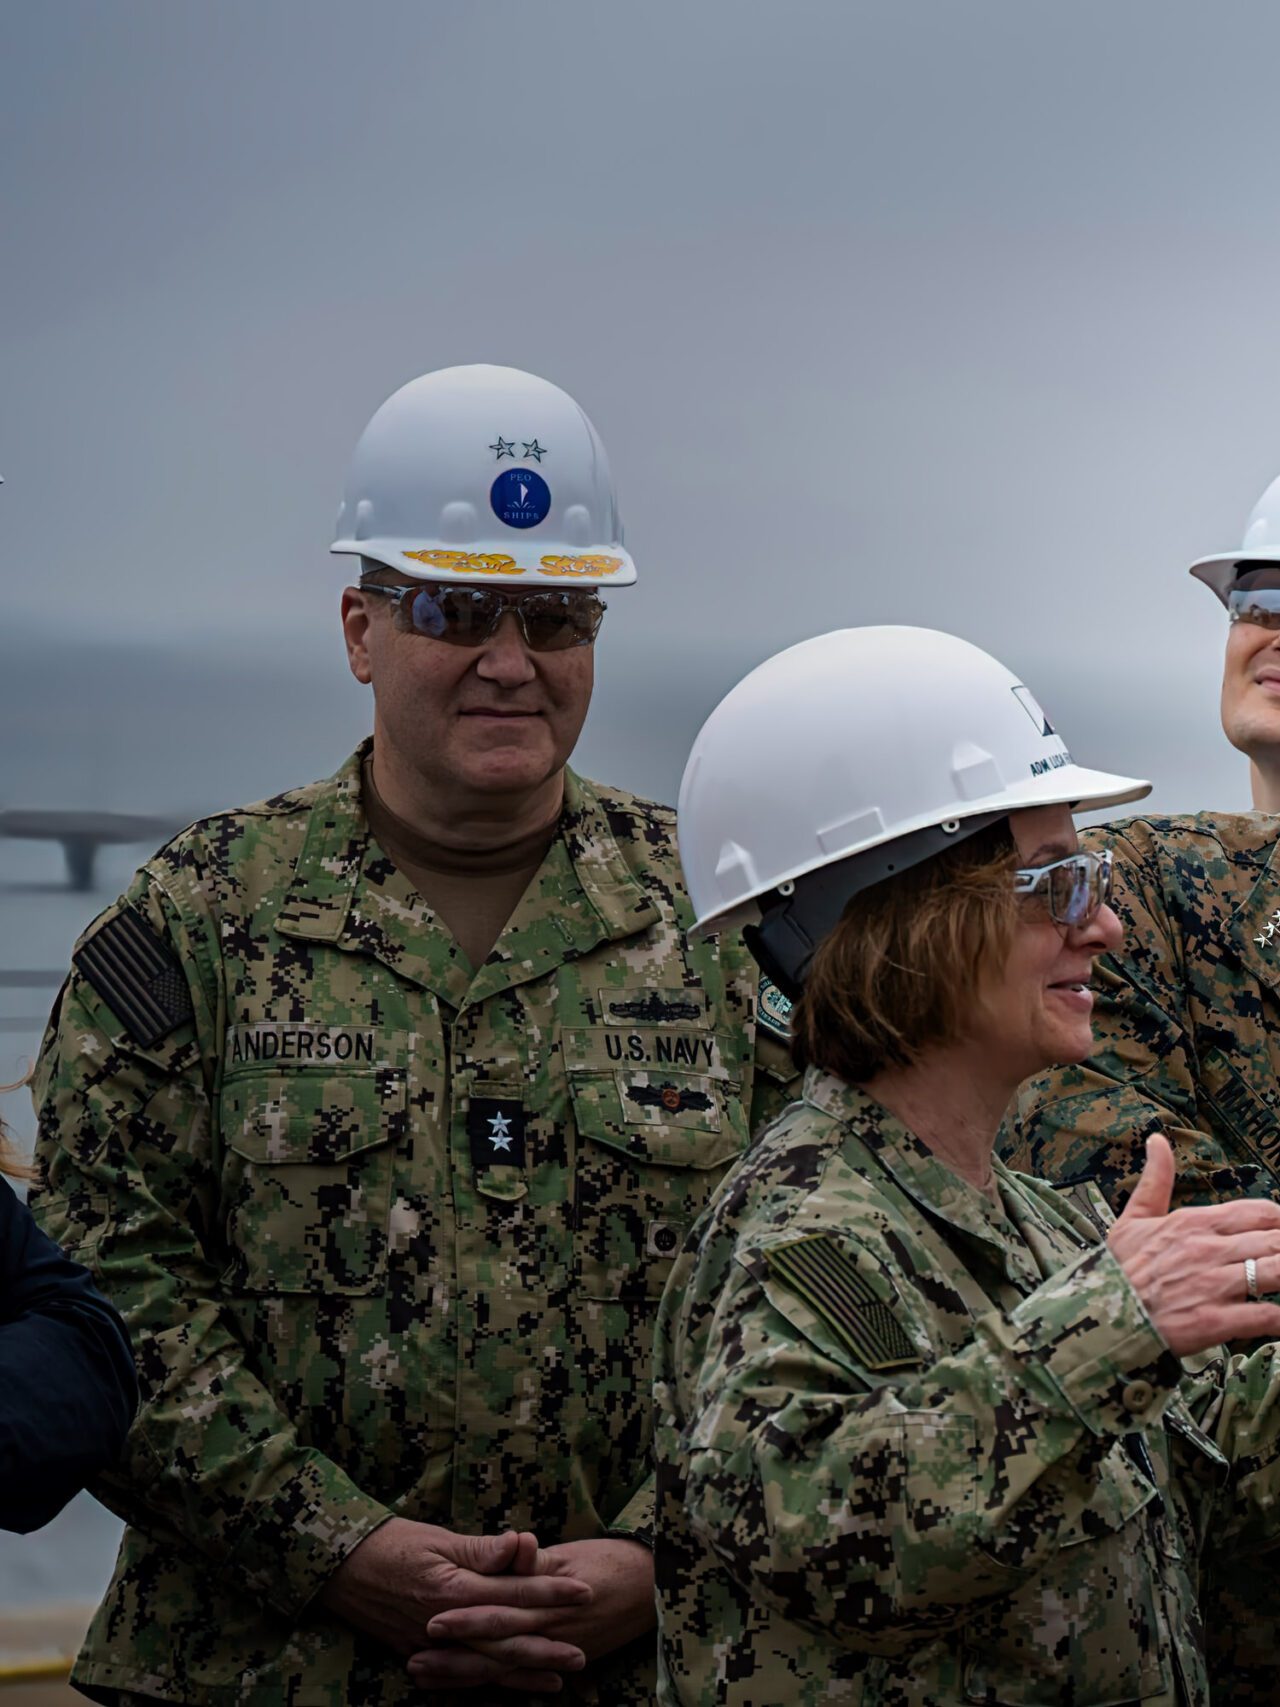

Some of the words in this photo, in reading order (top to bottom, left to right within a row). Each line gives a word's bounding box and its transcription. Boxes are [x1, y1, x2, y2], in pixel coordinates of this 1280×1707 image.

[1030, 759, 1051, 777] ADM
[232, 1030, 374, 1061] ANDERSON
[605, 1034, 651, 1061] U.S.
[655, 1035, 715, 1064] NAVY
